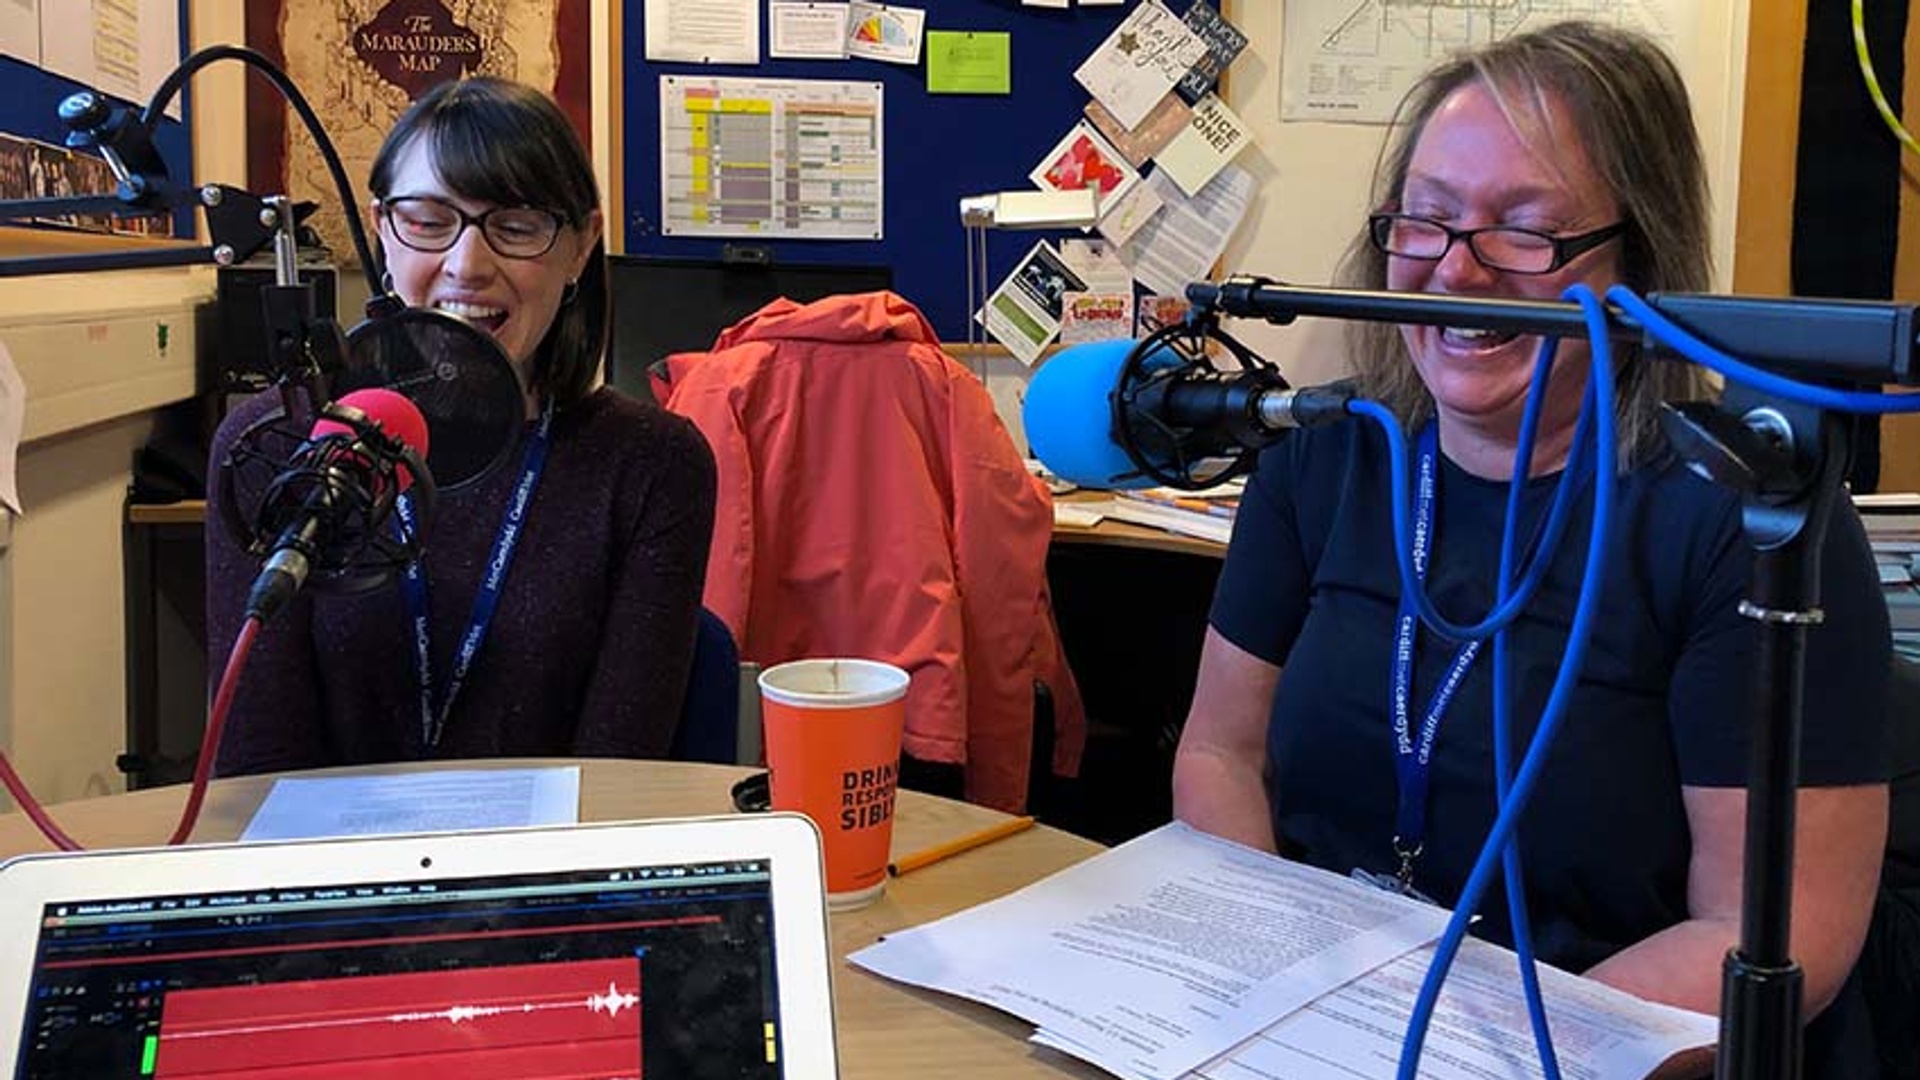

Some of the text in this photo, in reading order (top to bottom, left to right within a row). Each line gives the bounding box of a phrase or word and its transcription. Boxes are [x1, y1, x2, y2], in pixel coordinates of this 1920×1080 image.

[399, 53, 441, 71] MAP
[1192, 116, 1230, 154] ONE!
[1202, 105, 1241, 143] NICE
[1414, 454, 1433, 579] cardiffmetcaerdy
[1394, 616, 1413, 754] cardiffmetcaerdydd
[842, 762, 898, 791] DRIN
